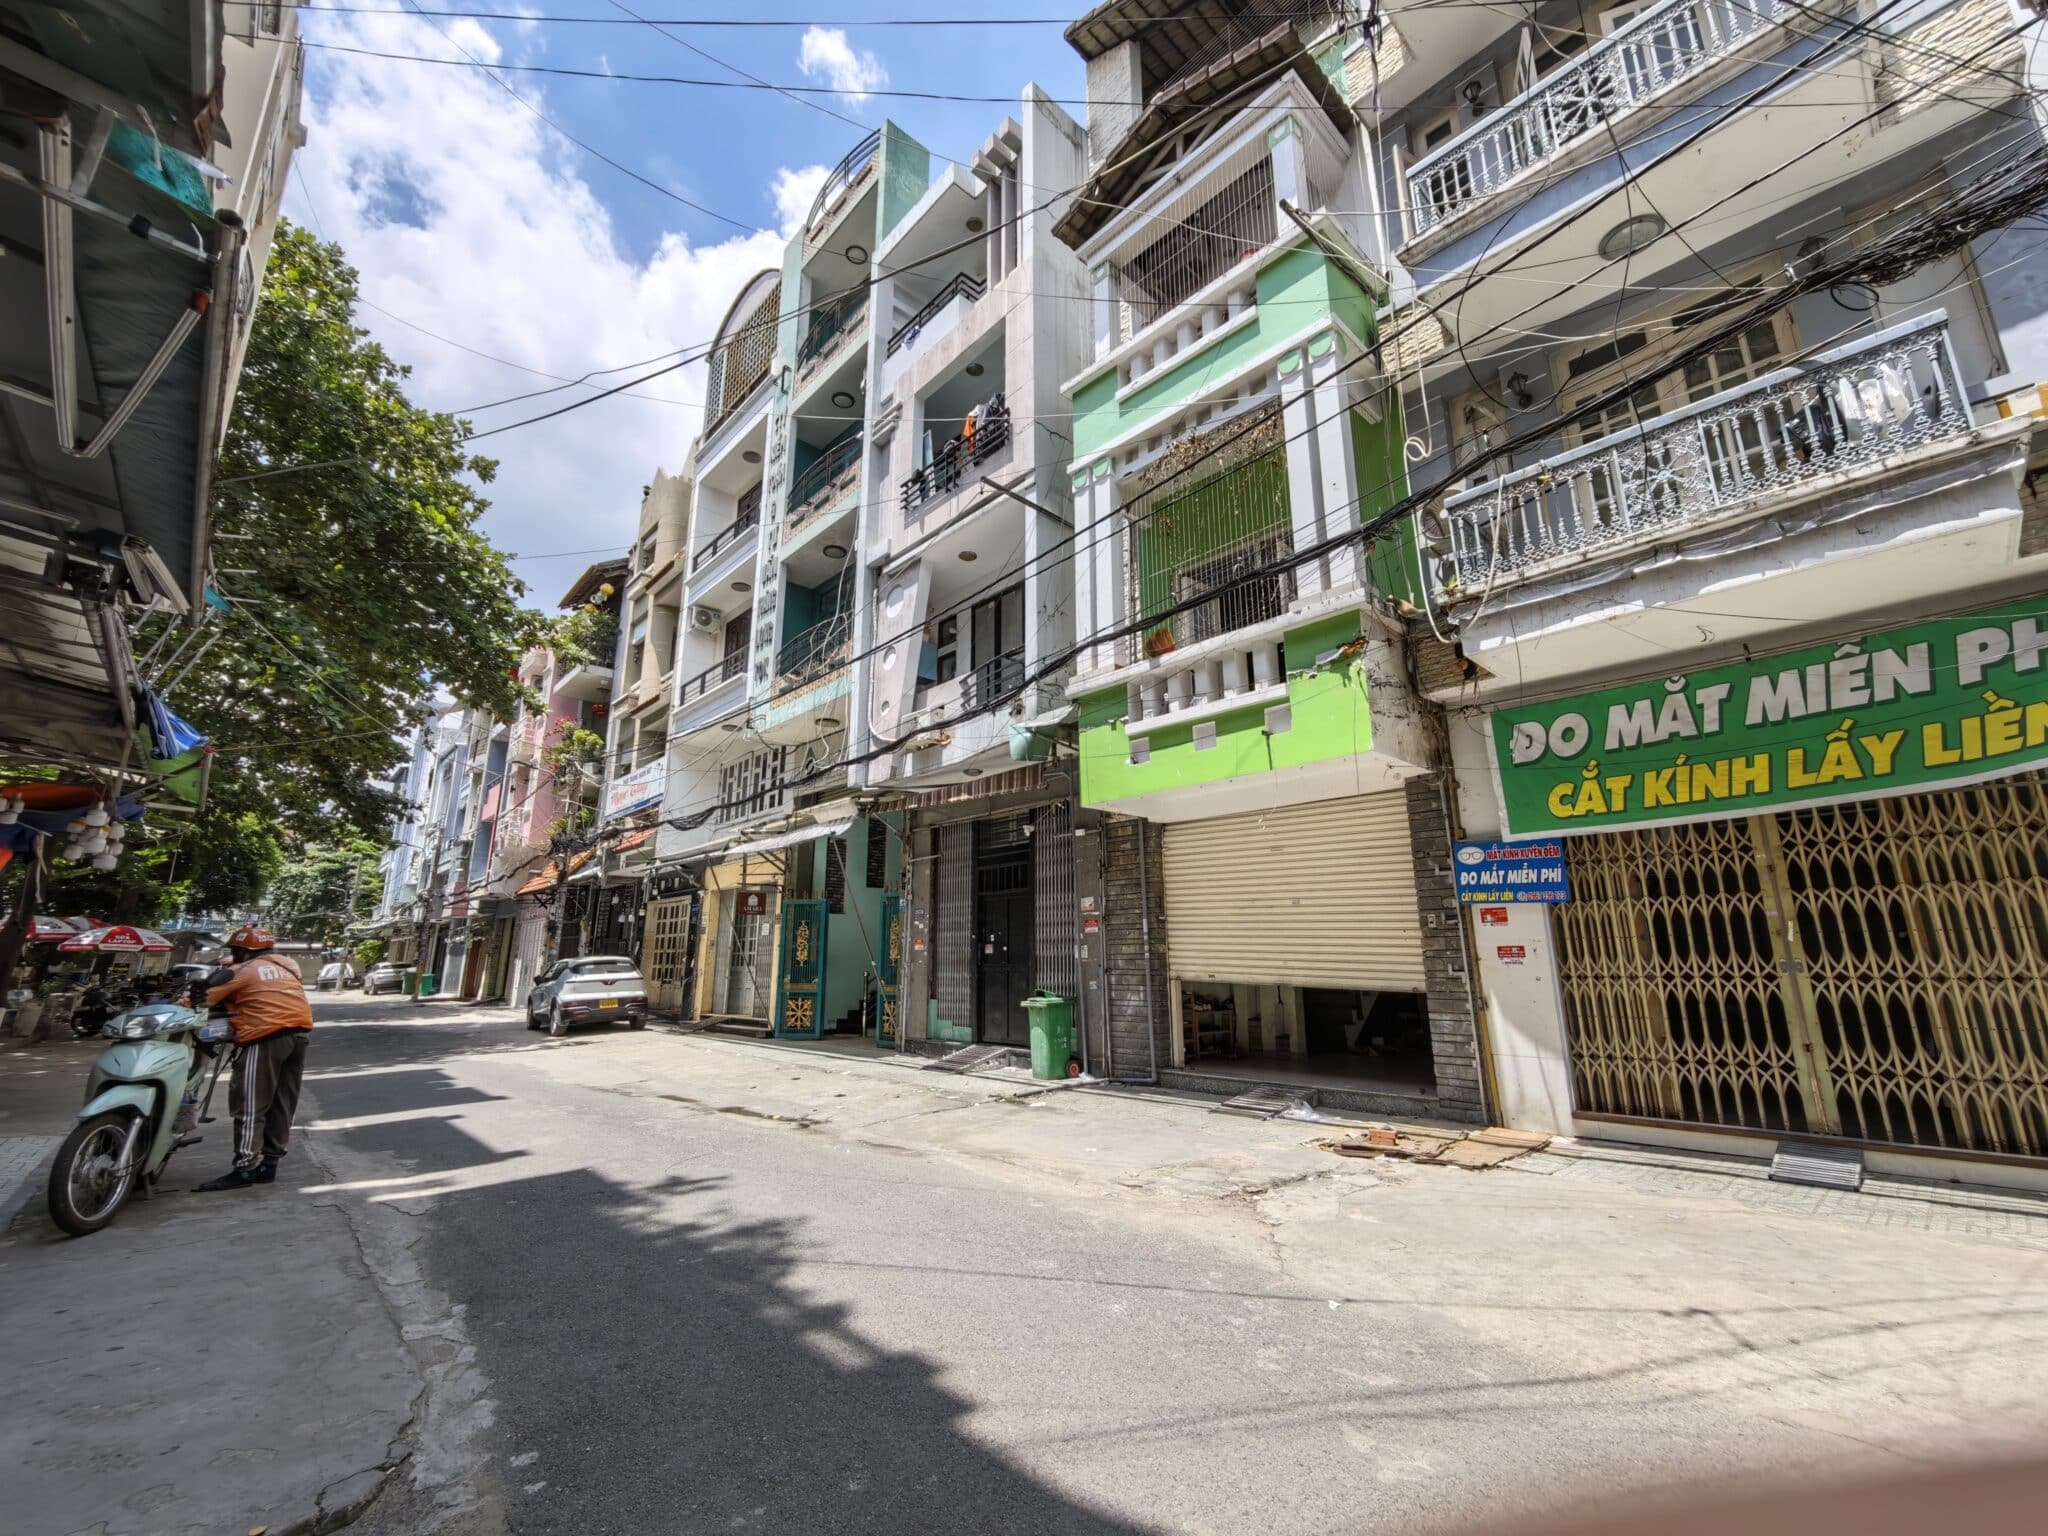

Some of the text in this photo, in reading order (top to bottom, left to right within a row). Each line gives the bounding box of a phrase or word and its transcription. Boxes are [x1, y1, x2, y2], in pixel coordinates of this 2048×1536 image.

[1509, 713, 1590, 764] ĐO
[1548, 759, 1632, 818] CẮT
[1644, 754, 1770, 808] KÍNH
[1787, 718, 1905, 788] LẤY
[1460, 862, 1562, 885] ĐO MẮT MIỄN PHÍ
